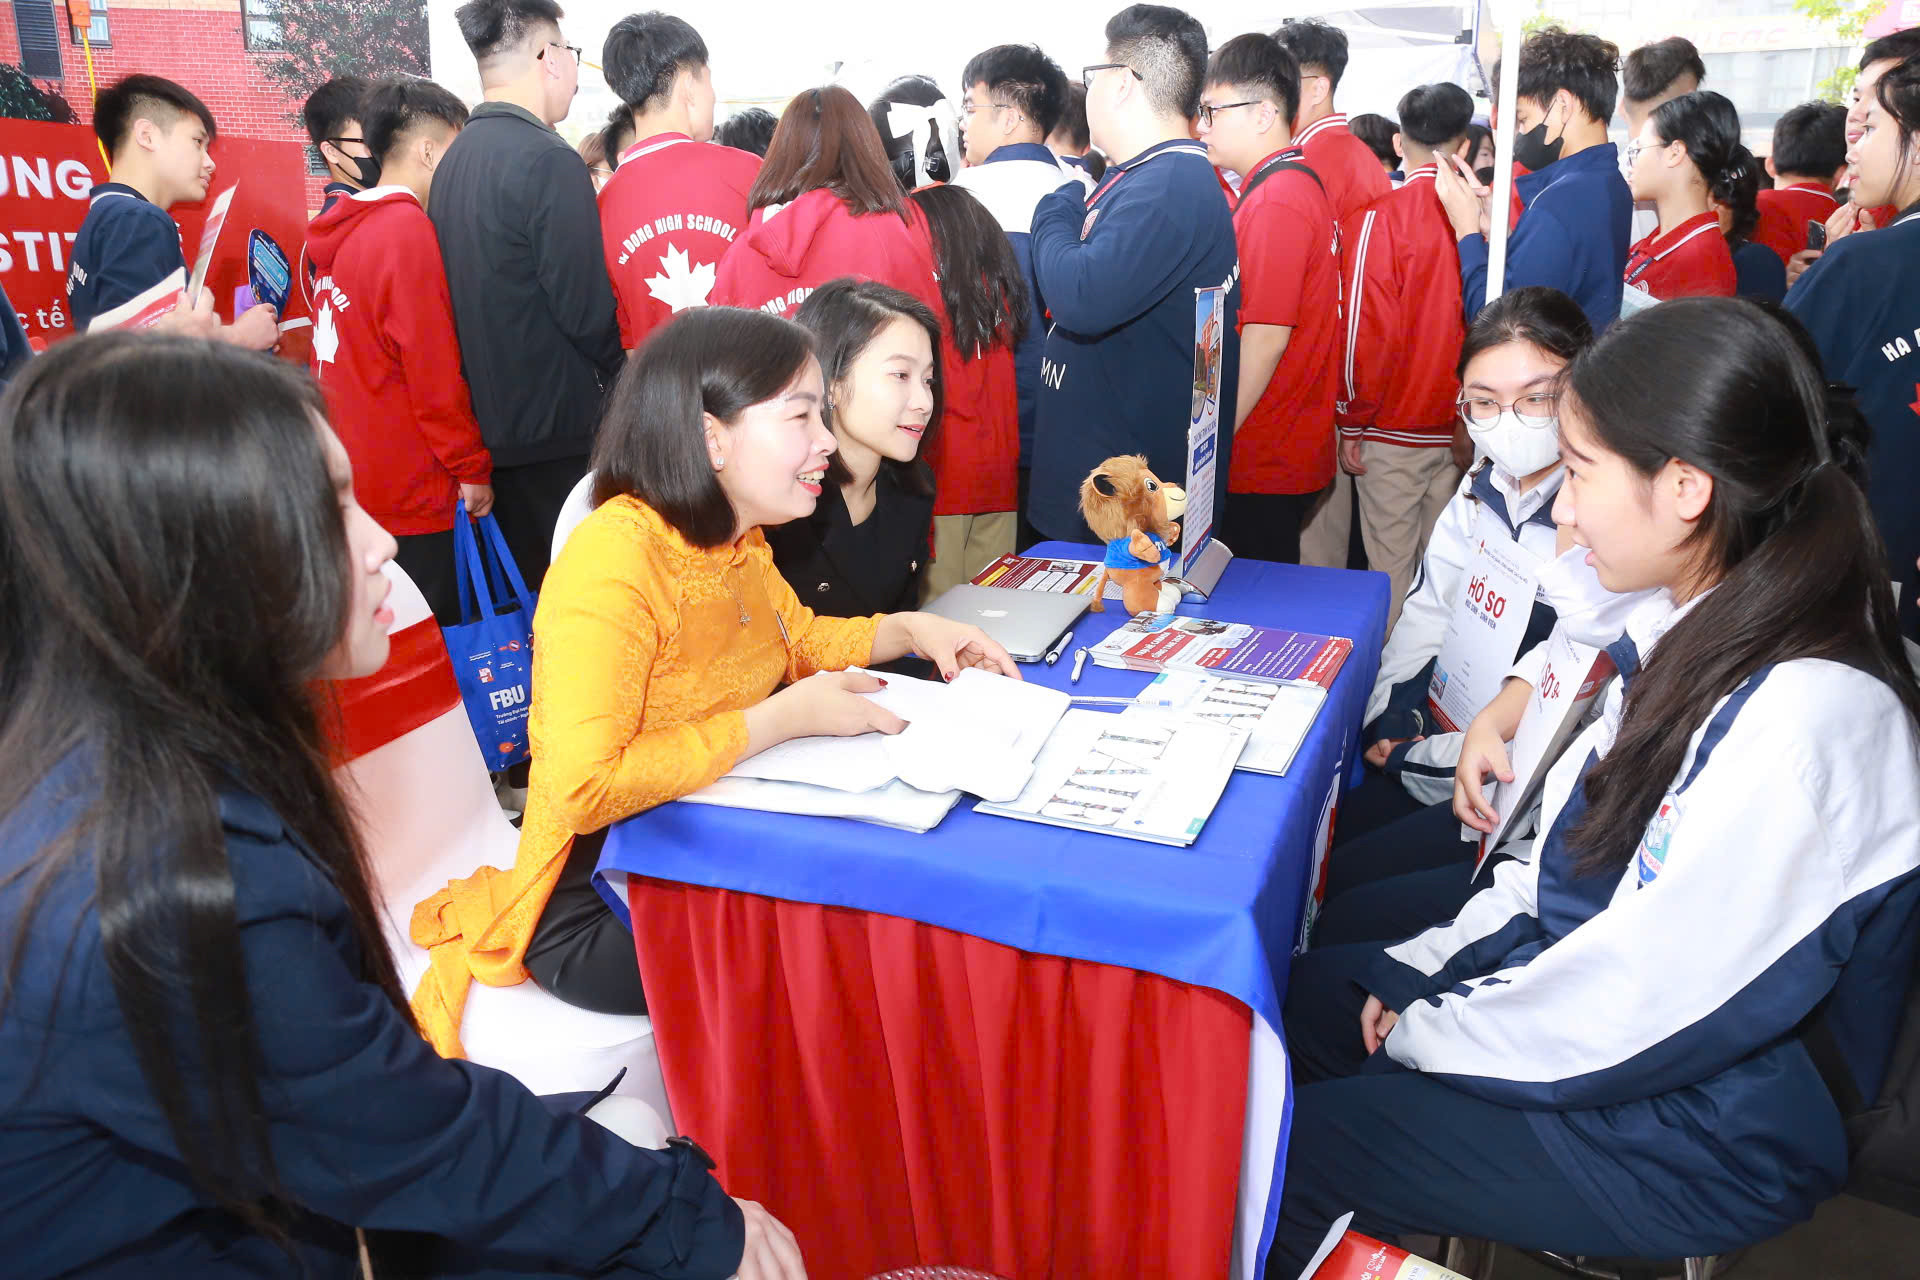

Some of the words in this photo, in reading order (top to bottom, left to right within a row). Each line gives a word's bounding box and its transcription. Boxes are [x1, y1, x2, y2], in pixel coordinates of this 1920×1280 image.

[622, 223, 655, 254] DONG
[654, 213, 683, 235] HIGH
[686, 213, 737, 243] SCHOOL
[36, 299, 65, 329] tế
[1881, 336, 1912, 362] HA
[1467, 574, 1488, 603] HỒ
[1484, 590, 1507, 619] SƠ
[489, 684, 525, 711] FBU
